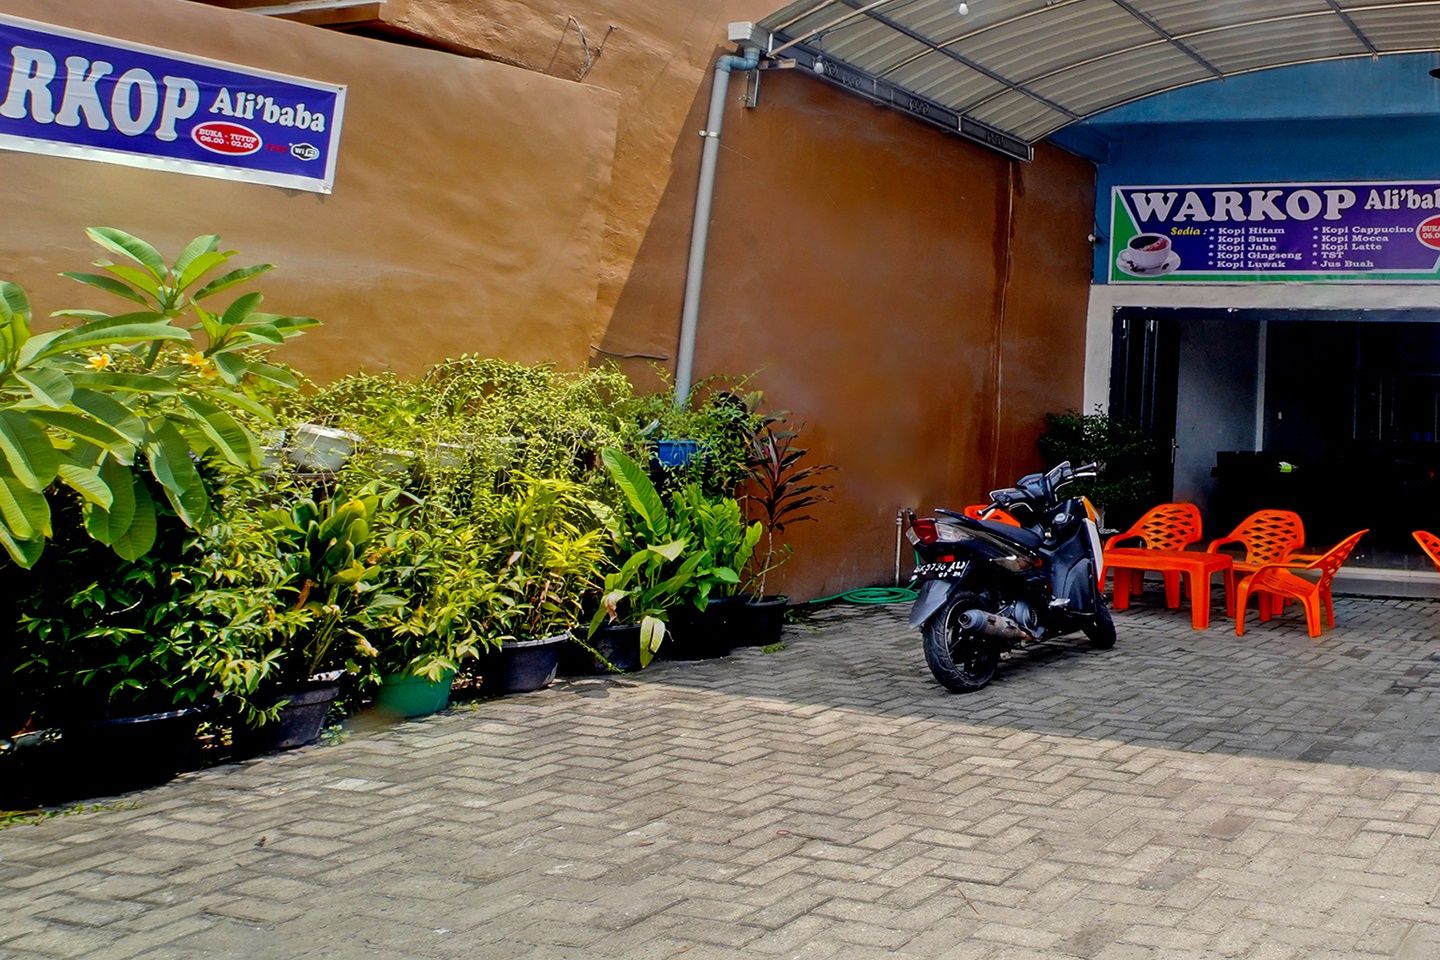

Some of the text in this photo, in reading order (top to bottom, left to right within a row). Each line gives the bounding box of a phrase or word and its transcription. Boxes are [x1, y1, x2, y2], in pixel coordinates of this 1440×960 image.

[0, 45, 325, 141] RKOP Ali'baba
[200, 135, 224, 145] 06.00
[231, 140, 254, 149] 02.00
[230, 133, 257, 143] TUTUP
[1130, 189, 1356, 222] WARKOP
[1170, 227, 1200, 236] Sedia
[1218, 227, 1245, 235] Kopi
[1322, 226, 1414, 235] Kopi Cappucino
[1218, 235, 1277, 243] Kopi Susu
[1322, 235, 1348, 243] Kopi
[1217, 243, 1245, 252] Kopi
[1321, 243, 1348, 251] Kopi
[1217, 251, 1302, 260] Kopi Gingseng
[1321, 251, 1344, 259] TST
[1217, 260, 1286, 269] Kopi Luwak
[1320, 260, 1374, 268] Jus Buah
